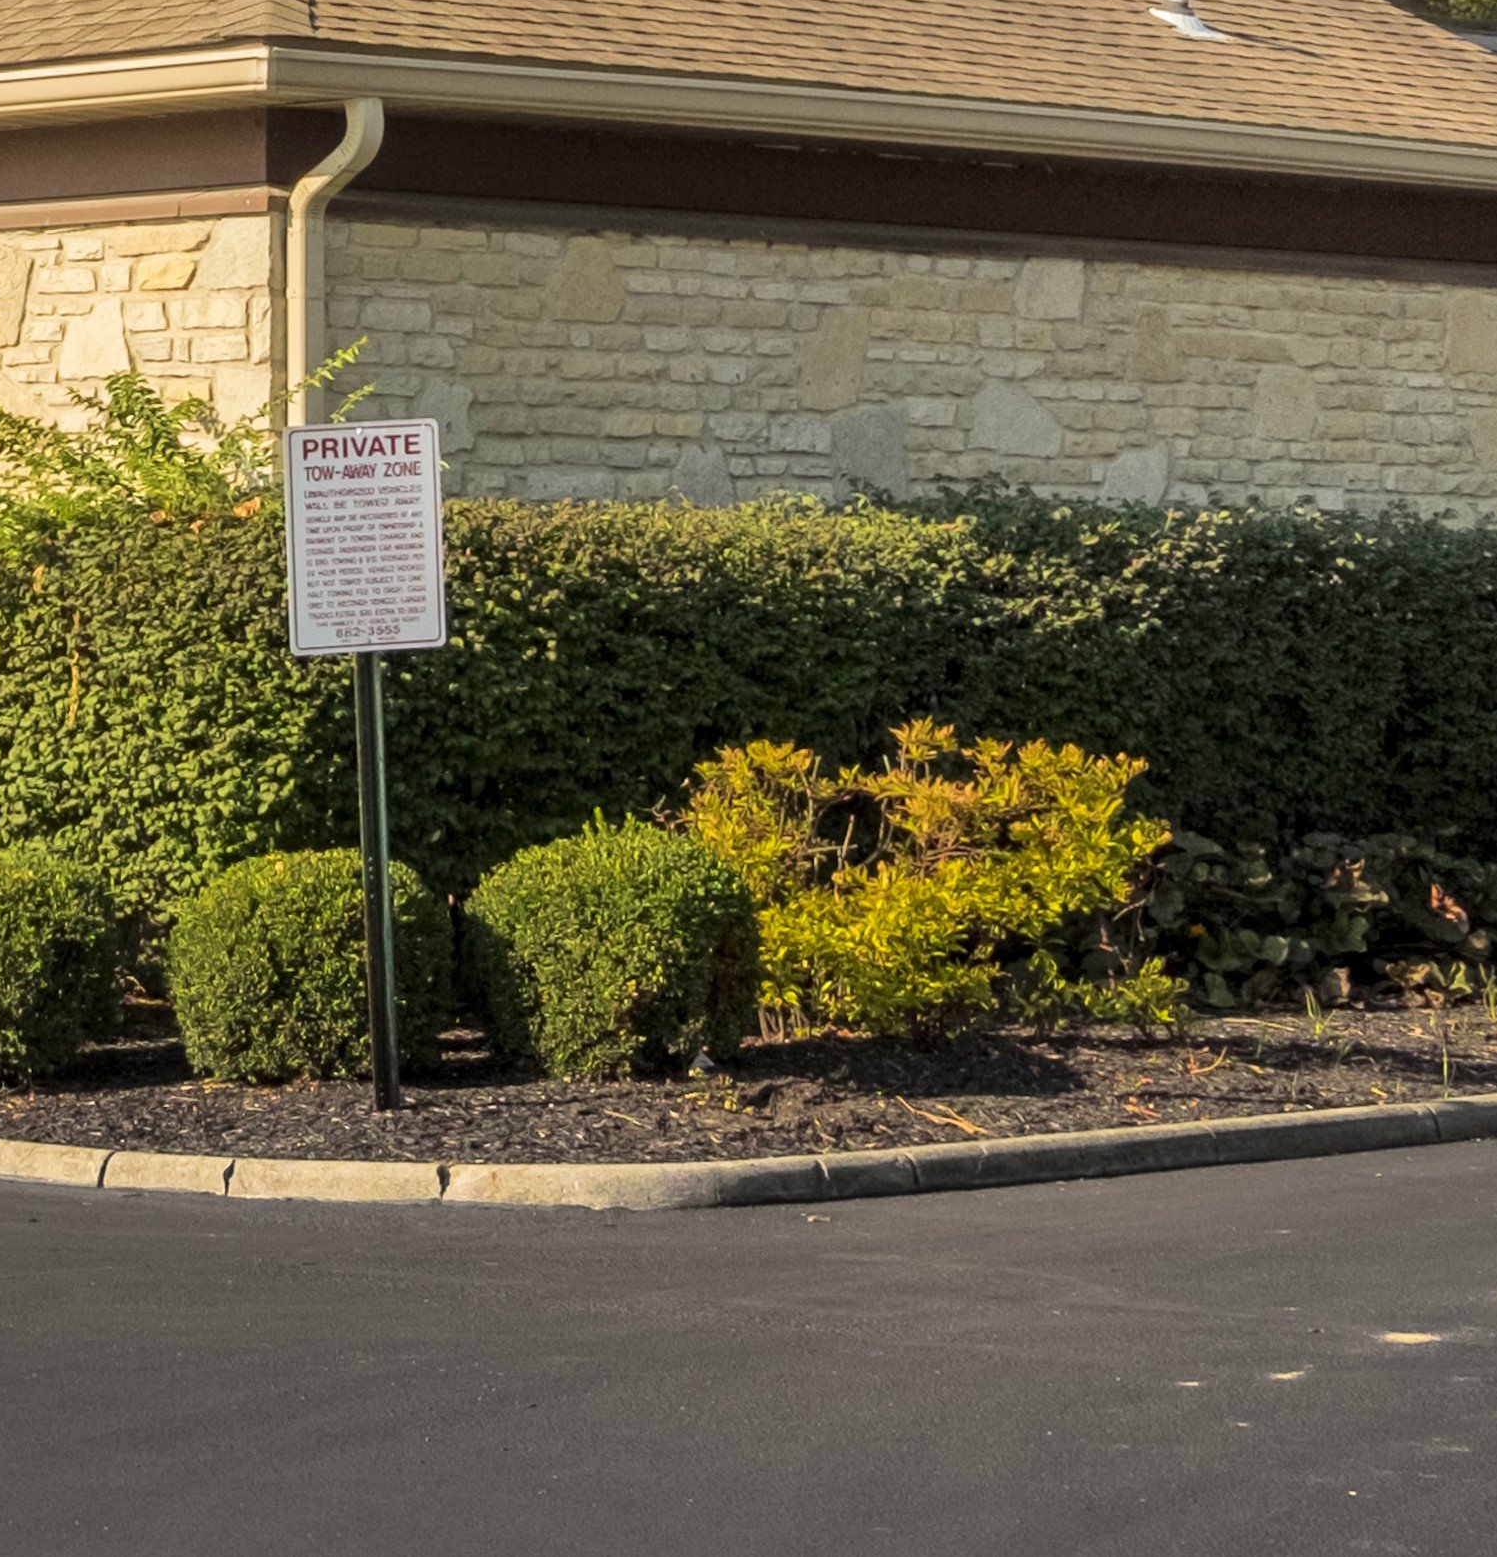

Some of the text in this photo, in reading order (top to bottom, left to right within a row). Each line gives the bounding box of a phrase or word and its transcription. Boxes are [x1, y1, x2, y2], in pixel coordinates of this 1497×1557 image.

[302, 433, 422, 461] PRIVATE
[304, 461, 422, 482] TOW-AWAY ZONE
